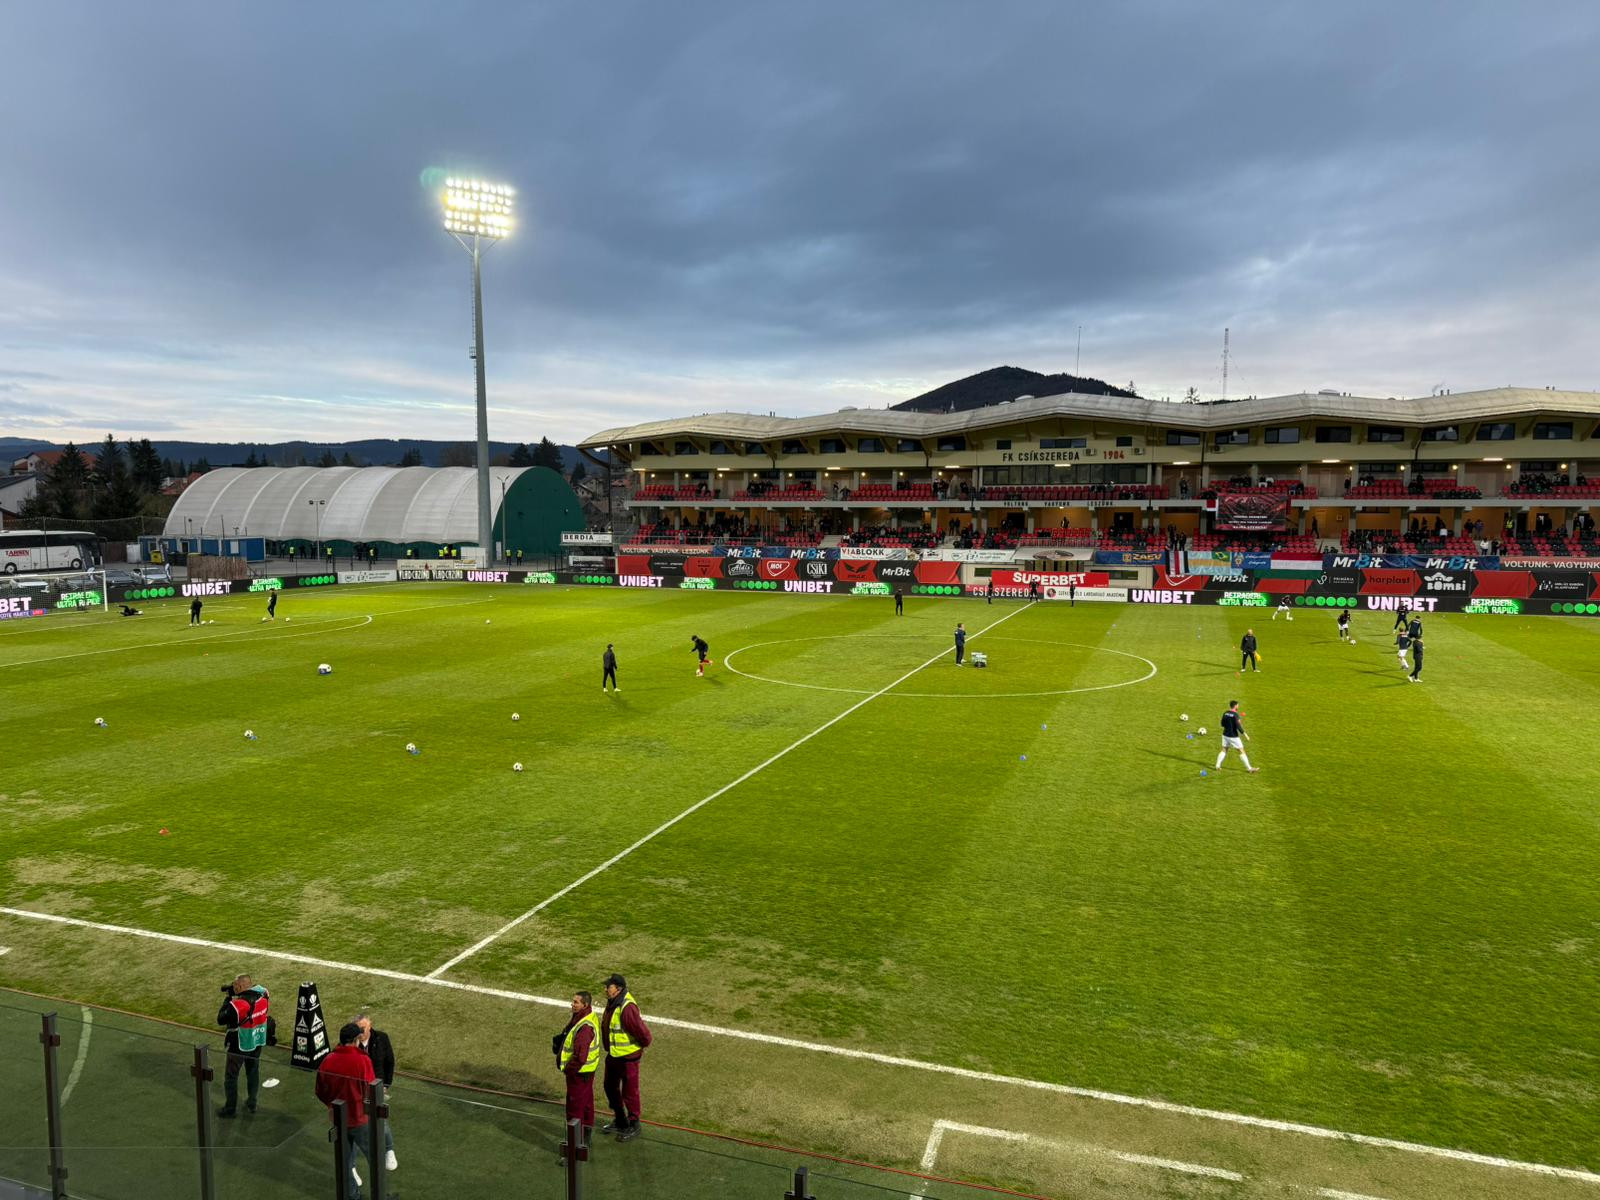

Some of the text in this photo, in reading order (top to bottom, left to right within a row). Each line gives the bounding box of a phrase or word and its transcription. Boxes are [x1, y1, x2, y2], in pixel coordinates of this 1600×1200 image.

[1003, 450, 1080, 462] FK CSÍKSZEREDA
[1103, 451, 1125, 461] 1904
[727, 547, 762, 558] MrBit
[790, 548, 827, 559] MrBit
[841, 548, 884, 556] VIABLOKK
[1333, 554, 1384, 569] MrBit
[1425, 556, 1479, 571] MrBit
[1504, 560, 1551, 568] VOLTUNK.
[467, 571, 510, 582] UNIBET
[881, 567, 911, 576] MrBit
[619, 575, 665, 587] UNIBET
[1012, 572, 1086, 586] SUPERBET
[1368, 576, 1410, 585] harplast
[182, 582, 232, 596] UNIBET
[784, 581, 834, 593] UNIBET
[1132, 589, 1195, 604] UNIBET
[1367, 596, 1438, 612] UNIBET
[1464, 605, 1519, 615] ULTRA RAPIDE
